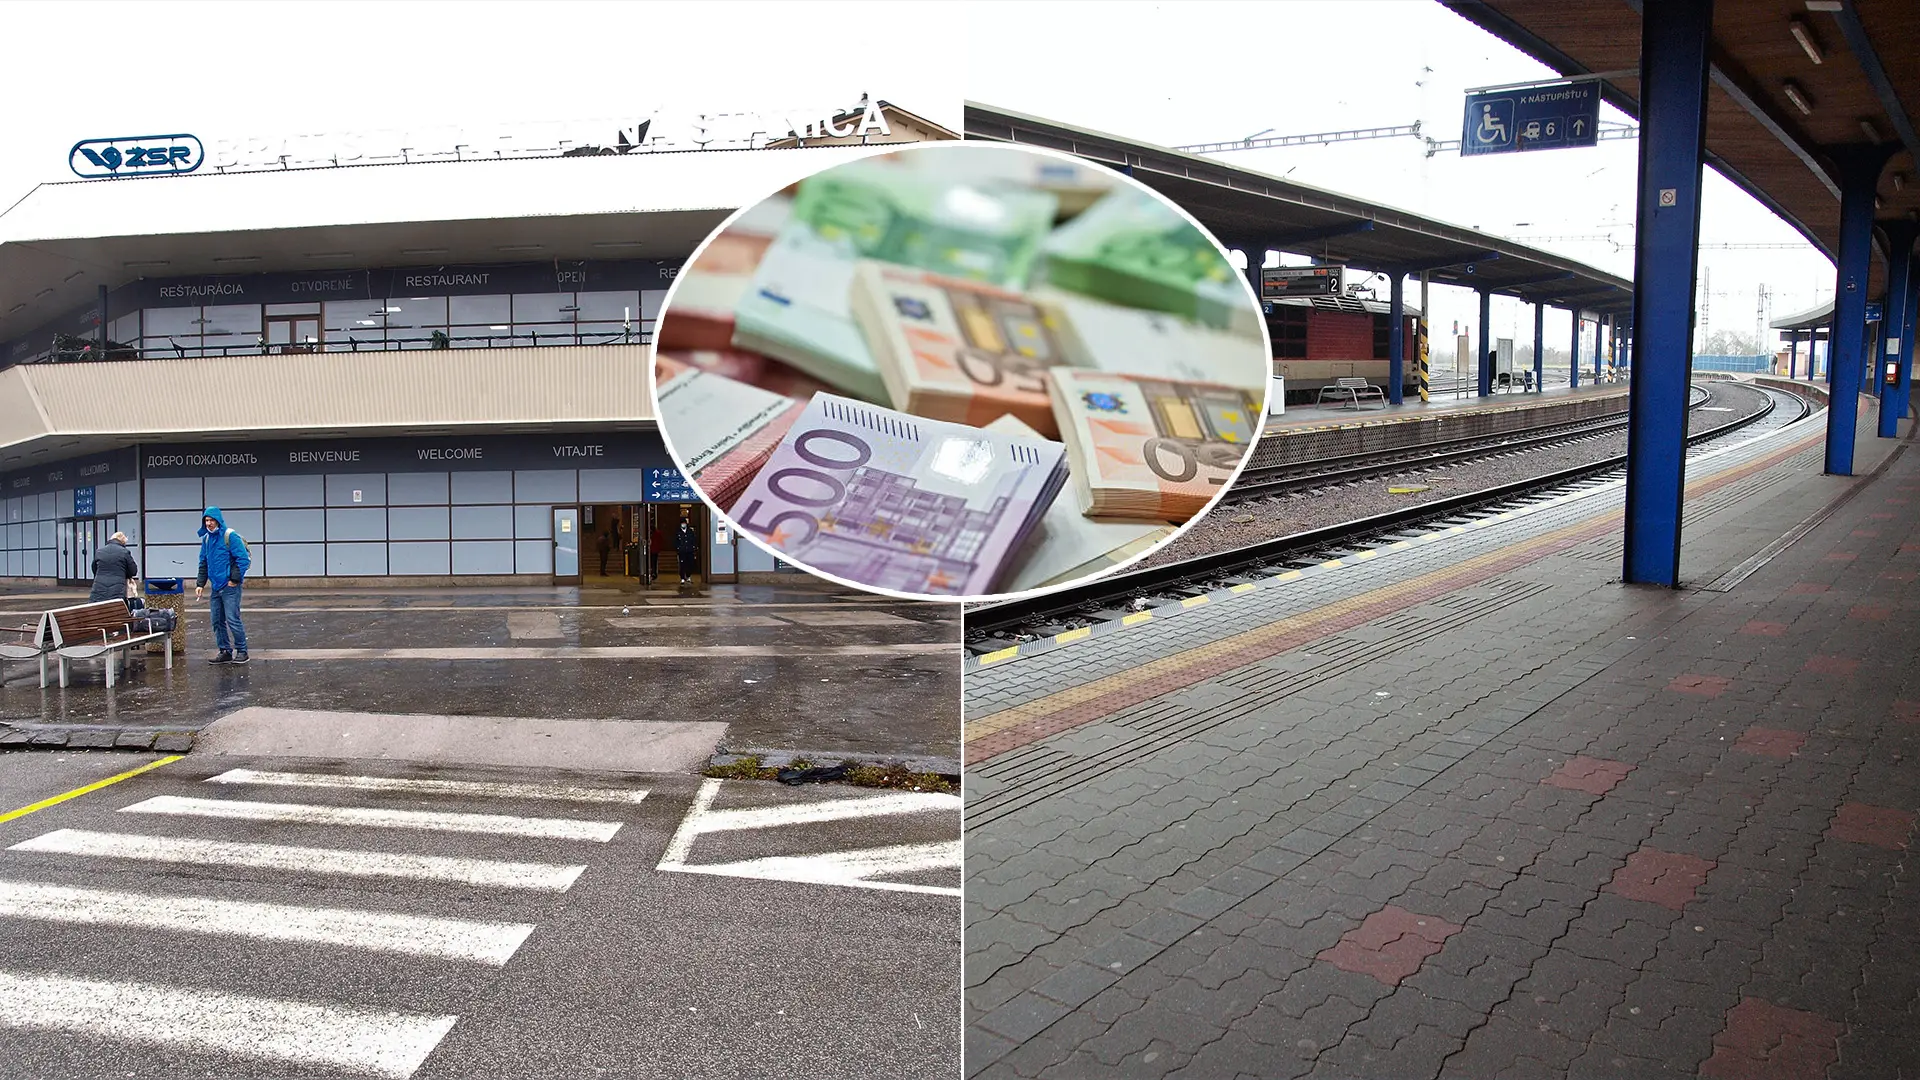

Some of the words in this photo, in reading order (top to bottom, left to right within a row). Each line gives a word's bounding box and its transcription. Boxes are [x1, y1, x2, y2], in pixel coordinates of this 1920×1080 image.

[1520, 96, 1527, 104] K
[1528, 90, 1581, 103] NÁSTUPIŠŤU
[1546, 122, 1555, 136] 6
[1467, 265, 1474, 274] C
[291, 275, 353, 293] OTVORENÉ
[405, 273, 490, 287] RESTAURANT
[557, 271, 586, 283] OPEN
[160, 282, 243, 298] REŠTAURÁCIA
[1330, 278, 1338, 292] 2
[289, 450, 360, 463] BIENVENUE
[417, 448, 483, 460] WELCOME
[552, 445, 603, 457] VITAJTE
[147, 455, 183, 467] ДОБРО
[186, 453, 257, 466] ПОЖАЛОВАТЬ
[738, 428, 872, 546] 500
